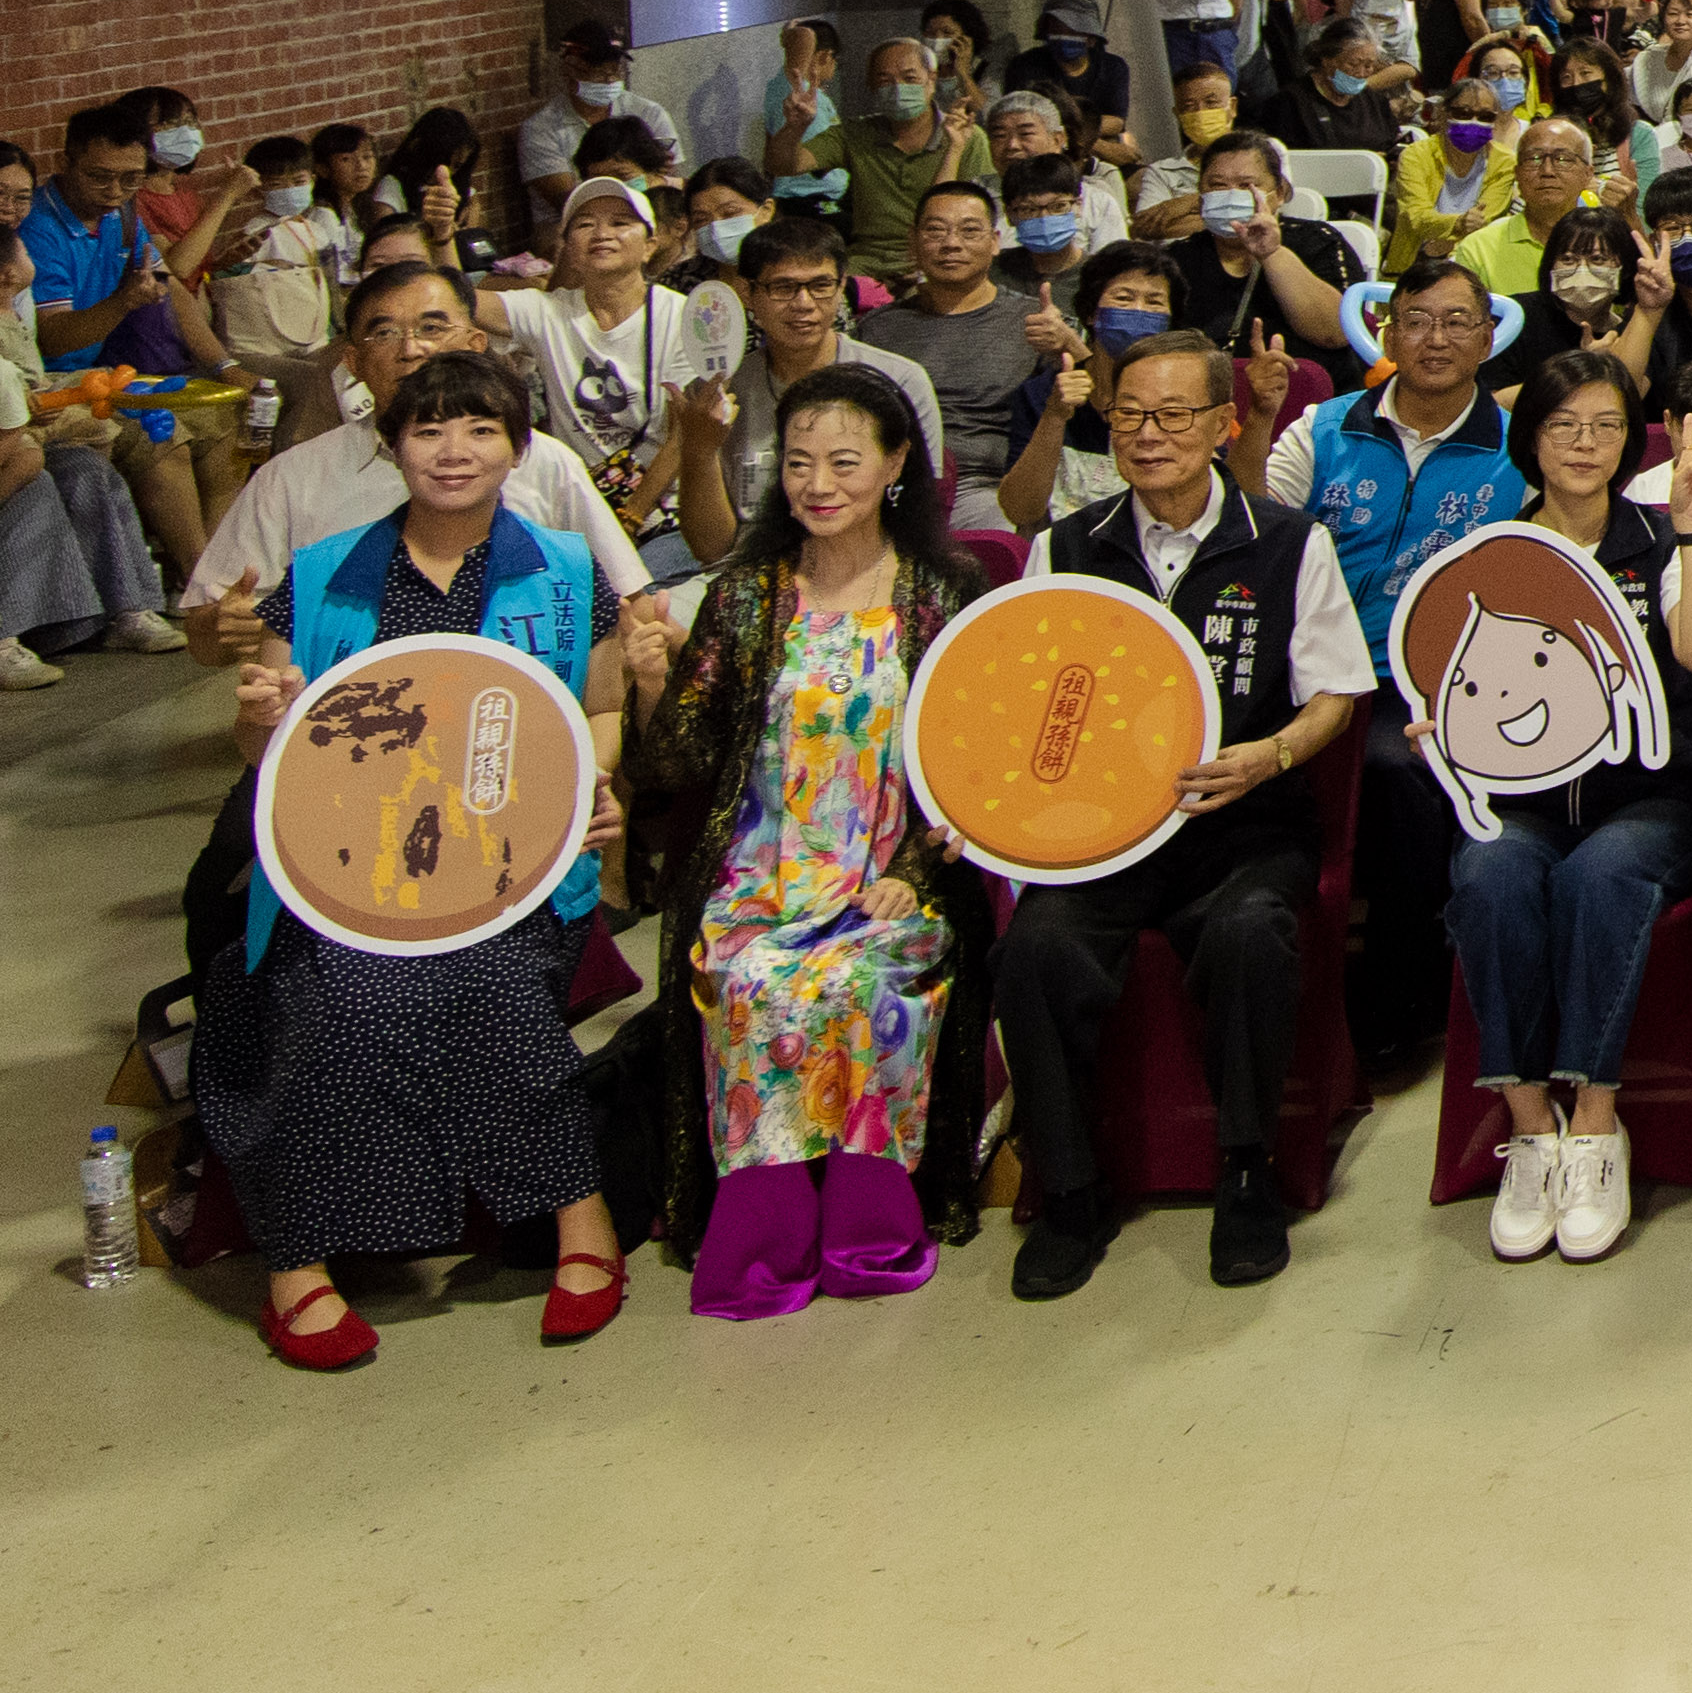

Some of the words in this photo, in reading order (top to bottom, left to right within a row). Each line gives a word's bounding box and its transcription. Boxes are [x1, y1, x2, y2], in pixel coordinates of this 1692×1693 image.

[498, 612, 551, 656] 江
[1232, 616, 1261, 696] 市政顧問
[469, 696, 511, 808] 祖親孫餅
[1037, 671, 1086, 779] 祖親孫餅
